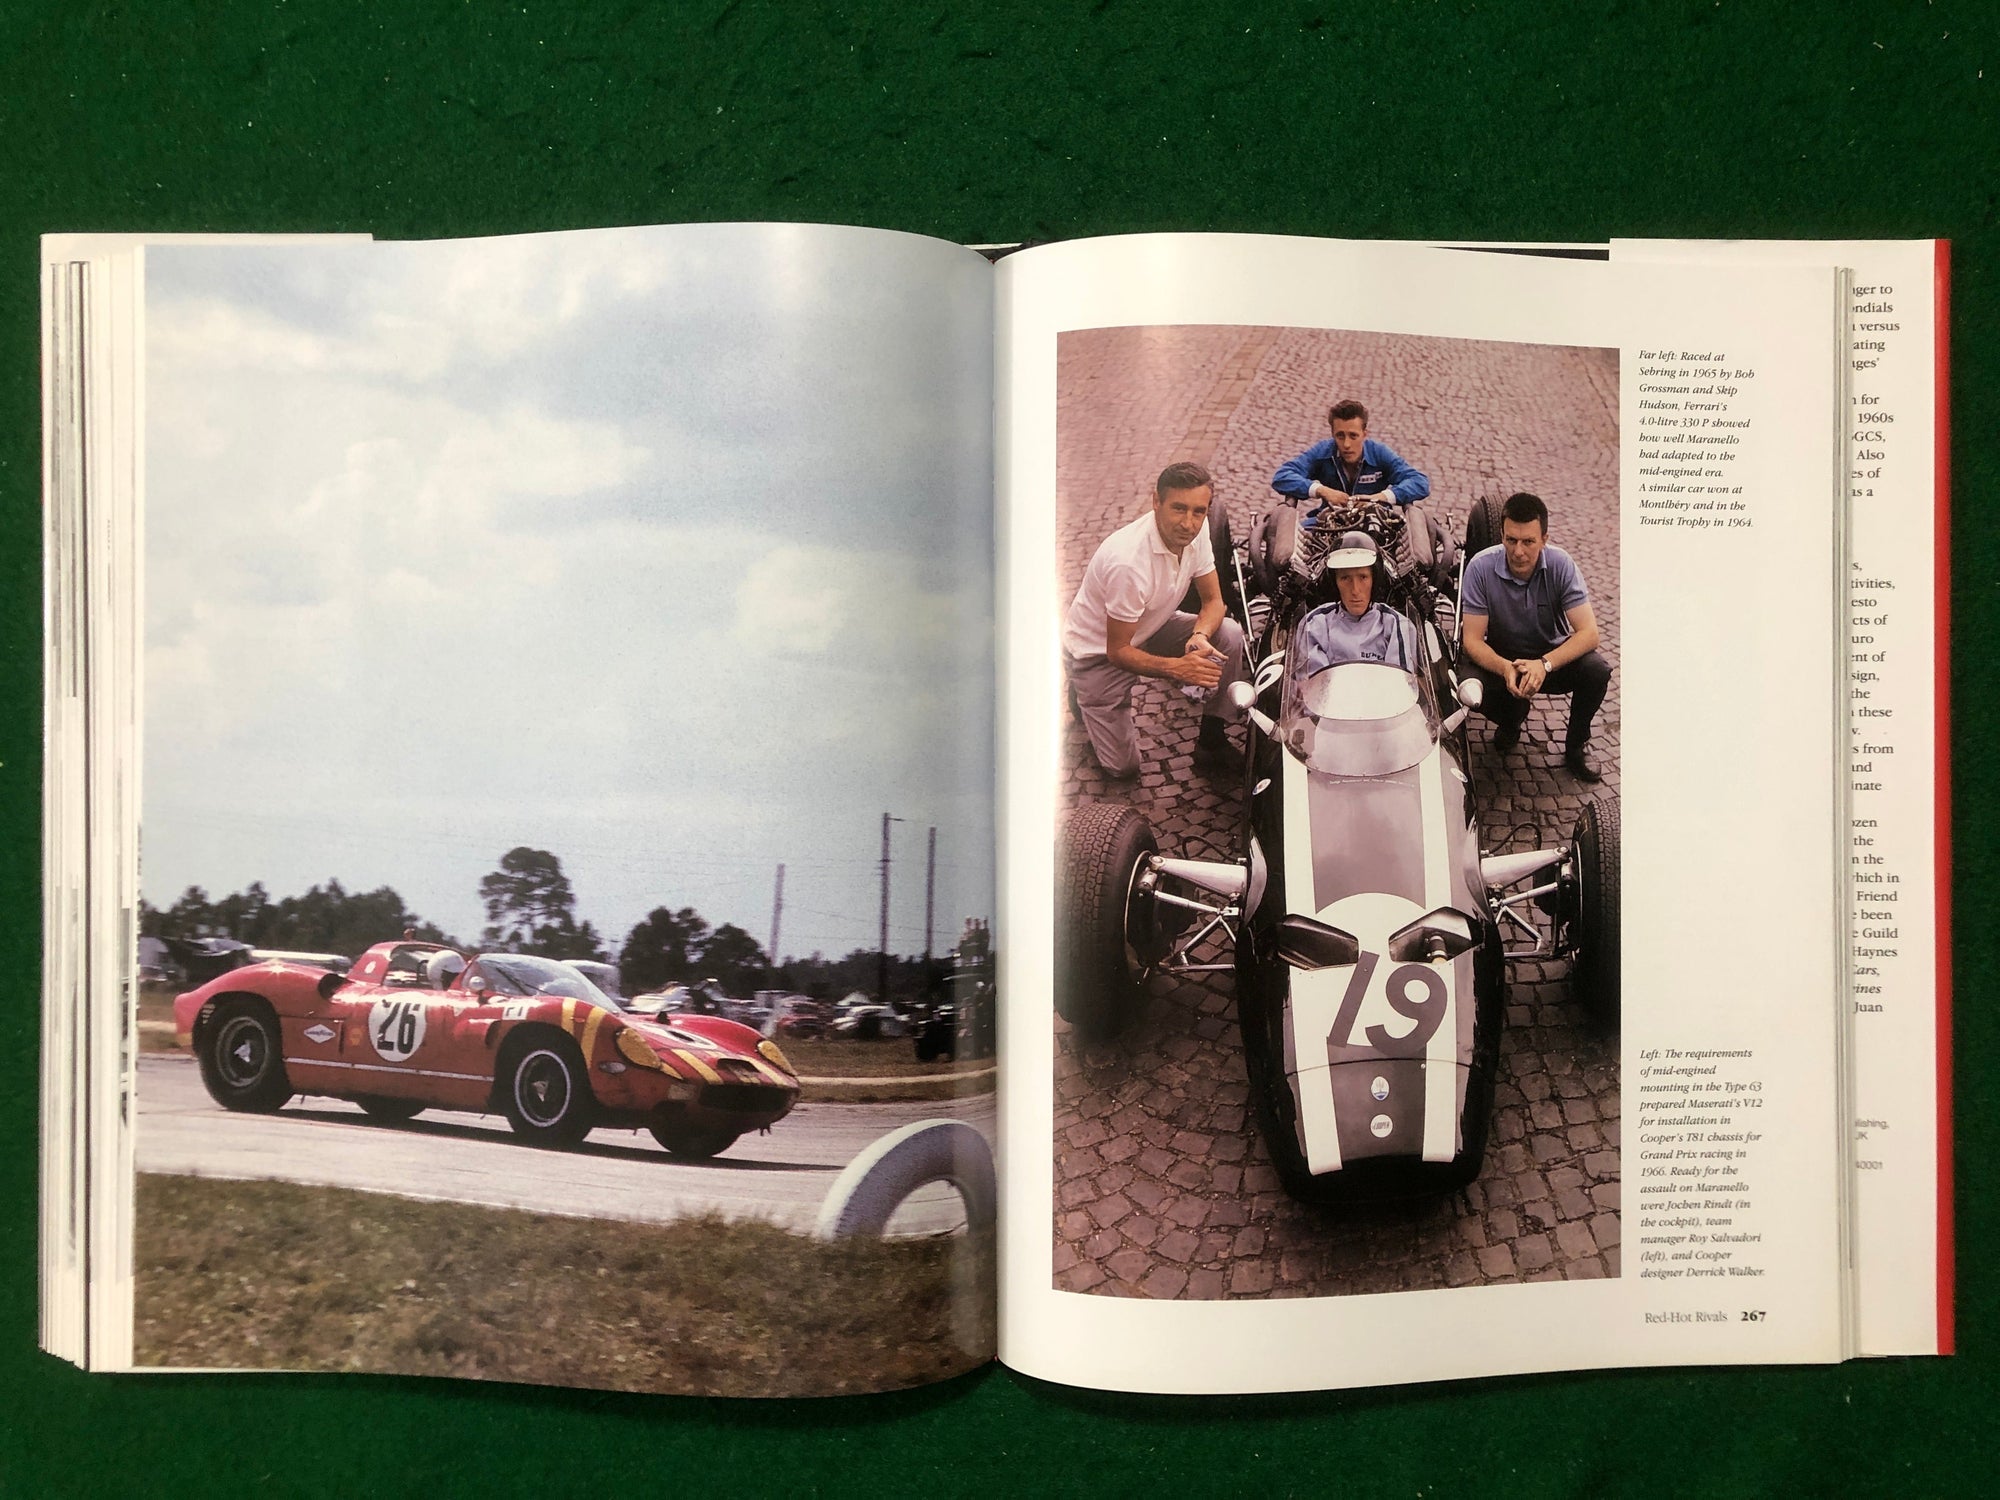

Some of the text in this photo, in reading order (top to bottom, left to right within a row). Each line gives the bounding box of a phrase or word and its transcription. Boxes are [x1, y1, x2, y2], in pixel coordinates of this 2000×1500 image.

[1880, 286, 1893, 294] to
[1852, 301, 1893, 313] ndials
[1860, 323, 1900, 331] versus
[1853, 339, 1885, 352] ating
[1639, 350, 1656, 359] Far
[1658, 350, 1677, 362] left:
[1680, 352, 1711, 361] Raced
[1639, 367, 1754, 381] Sebring in 1965 by Bob
[1639, 383, 1737, 397] Grossman and Skip
[1639, 400, 1727, 411] Hudson, Ferrari's
[1861, 394, 1880, 405] for
[1639, 416, 1750, 428] 4.0-litre 330 P showed
[1858, 412, 1894, 424] 1960s
[1639, 432, 1739, 444] how well Maranello
[1851, 430, 1886, 443] GCS,
[1639, 449, 1659, 459] had
[1661, 450, 1704, 462] adapted
[1719, 451, 1735, 461] the
[1856, 449, 1885, 460] Also
[1639, 466, 1703, 479] mid-engined
[1867, 467, 1882, 479] of
[1639, 483, 1646, 492] A
[1649, 483, 1686, 493] similar
[1732, 486, 1742, 494] at
[1639, 499, 1746, 512] Montlhéry and in the
[1640, 516, 1753, 529] Tourist Trophy in 1964.
[1852, 562, 1862, 571] s,
[1850, 578, 1895, 590] tivities,
[1851, 597, 1877, 607] esto
[1853, 614, 1888, 627] cts of
[1851, 636, 1874, 644] uro
[1872, 651, 1886, 662] of
[1851, 670, 1880, 683] sign,
[1851, 688, 1871, 699] the
[1859, 706, 1892, 717] these
[1862, 743, 1894, 754] from
[1852, 835, 1874, 847] the
[1863, 854, 1884, 864] the
[1852, 872, 1900, 883] hich in
[1856, 891, 1898, 901] Friend
[1861, 909, 1893, 920] been
[1862, 928, 1898, 938] Guild
[1852, 945, 1898, 959] Haynes
[1853, 1002, 1883, 1014] Juan
[377, 999, 421, 1054] 26
[1640, 1049, 1752, 1061] Left: The requirements
[1640, 1065, 1717, 1078] of mid-engined
[1640, 1081, 1762, 1094] mounting in the Type 63
[1639, 1098, 1763, 1111] prepared Maserati's V12
[1639, 1115, 1731, 1129] for installation in
[1640, 1132, 1762, 1145] Cooper's T81 chassis for
[1640, 1149, 1746, 1160] Grand Prix racing in
[1641, 1165, 1738, 1178] 1966. Ready for the
[1640, 1183, 1677, 1193] assault
[1695, 1182, 1749, 1192] Maranello
[1641, 1199, 1751, 1212] were Jochen Rindt (in
[1640, 1217, 1732, 1229] the cockpit), team
[1641, 1233, 1761, 1246] manager Roy Salvadori
[1641, 1250, 1732, 1263] (left), and Cooper
[1640, 1266, 1764, 1280] designer Derrick Walker.
[1645, 1310, 1767, 1323] Red-Hot Rivals 267
